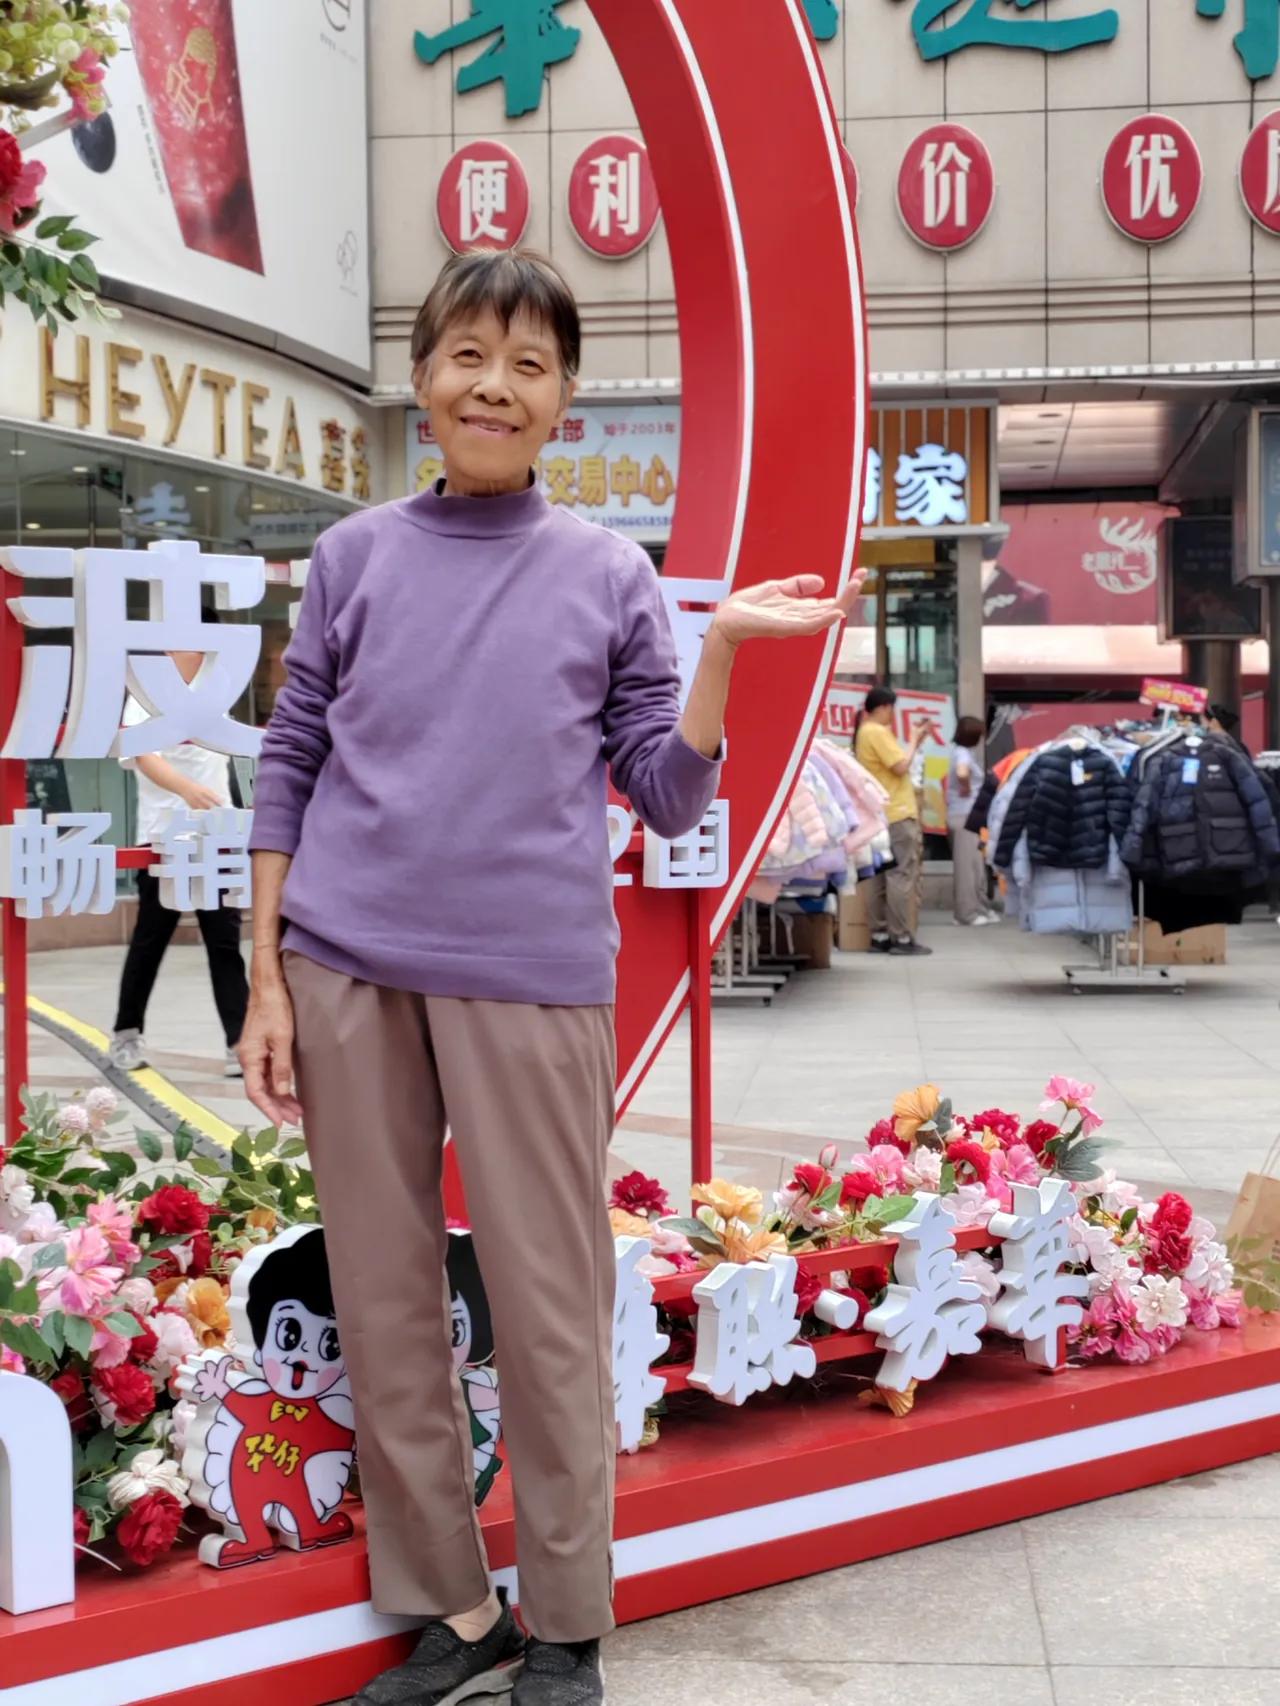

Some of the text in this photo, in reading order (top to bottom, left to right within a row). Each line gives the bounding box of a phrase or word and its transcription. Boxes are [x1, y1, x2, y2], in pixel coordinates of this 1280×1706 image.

[919, 142, 972, 228] 价
[39, 326, 305, 479] HEYTEA
[543, 454, 676, 507] 交易中心
[862, 442, 968, 526] 家
[0, 540, 265, 759] 波
[0, 808, 253, 919] 畅销
